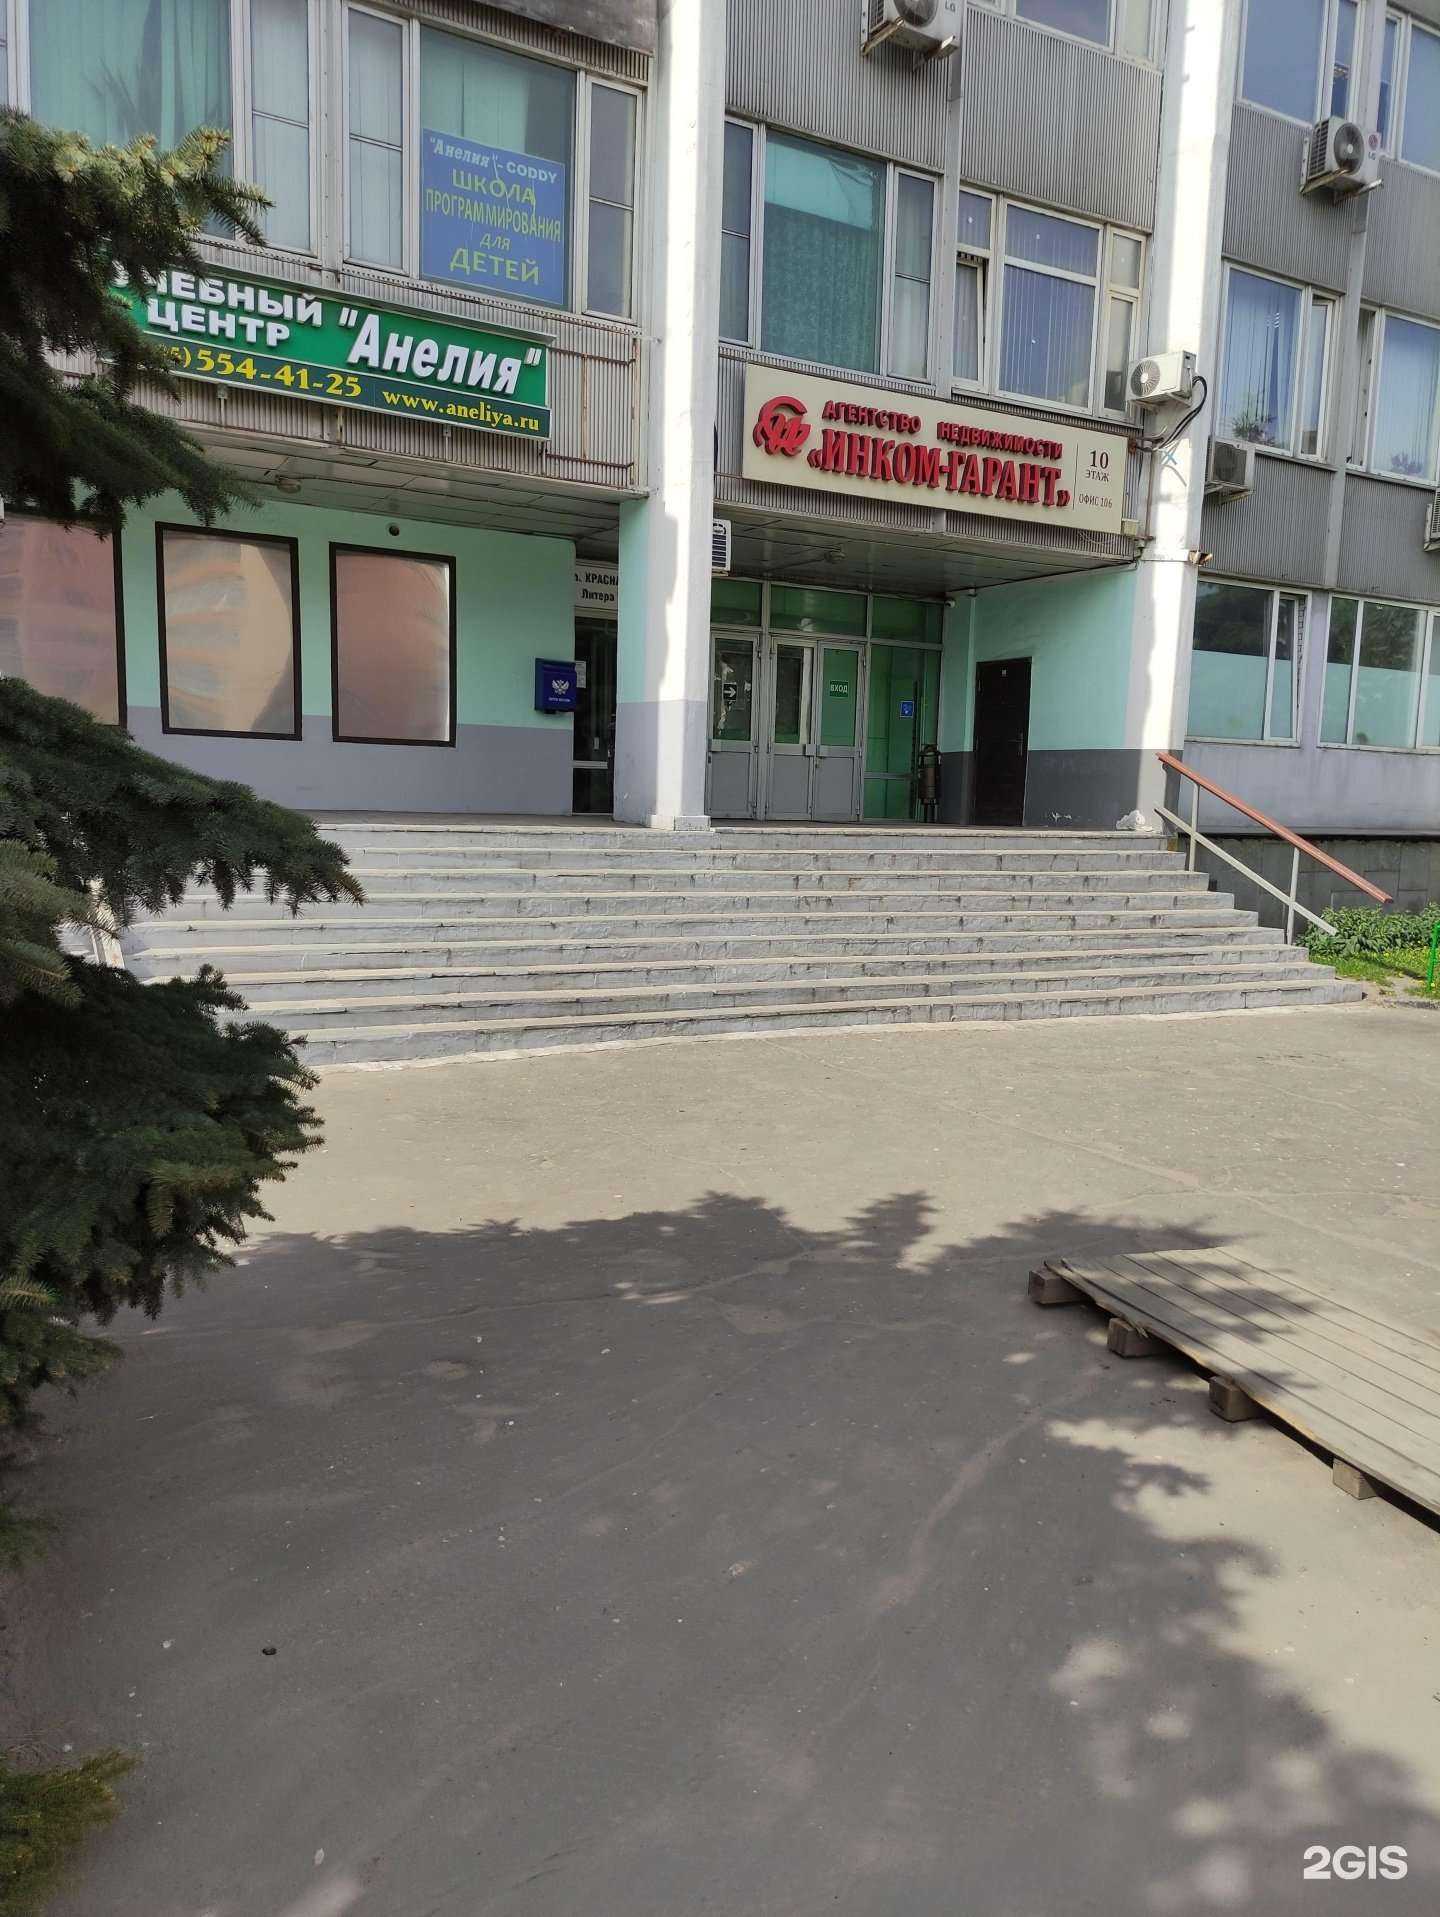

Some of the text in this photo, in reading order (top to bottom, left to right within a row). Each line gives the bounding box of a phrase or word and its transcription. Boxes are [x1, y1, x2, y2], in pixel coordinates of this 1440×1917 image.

[452, 168, 536, 206] ШКОЛА
[506, 161, 557, 184] CODDY
[425, 188, 561, 243] ПРОГРАММИРОВАНИЯ
[450, 248, 539, 285] ДЕТЕЙ
[147, 298, 290, 347] ЦЕНТР
[338, 307, 542, 394] "Анелия"
[382, 391, 539, 431] www.aneliya.ru
[822, 400, 1063, 460] АГЕНТСТВО НЕДВИЖИМОСТИ
[807, 428, 1071, 507] «ИНКОМ-ГАРАНТ»
[1085, 469, 1109, 482] ЭТАЖ
[1089, 449, 1109, 469] 10
[1079, 493, 1099, 506] ОФИС
[582, 588, 615, 603] Литера
[830, 684, 848, 694] ВХОД
